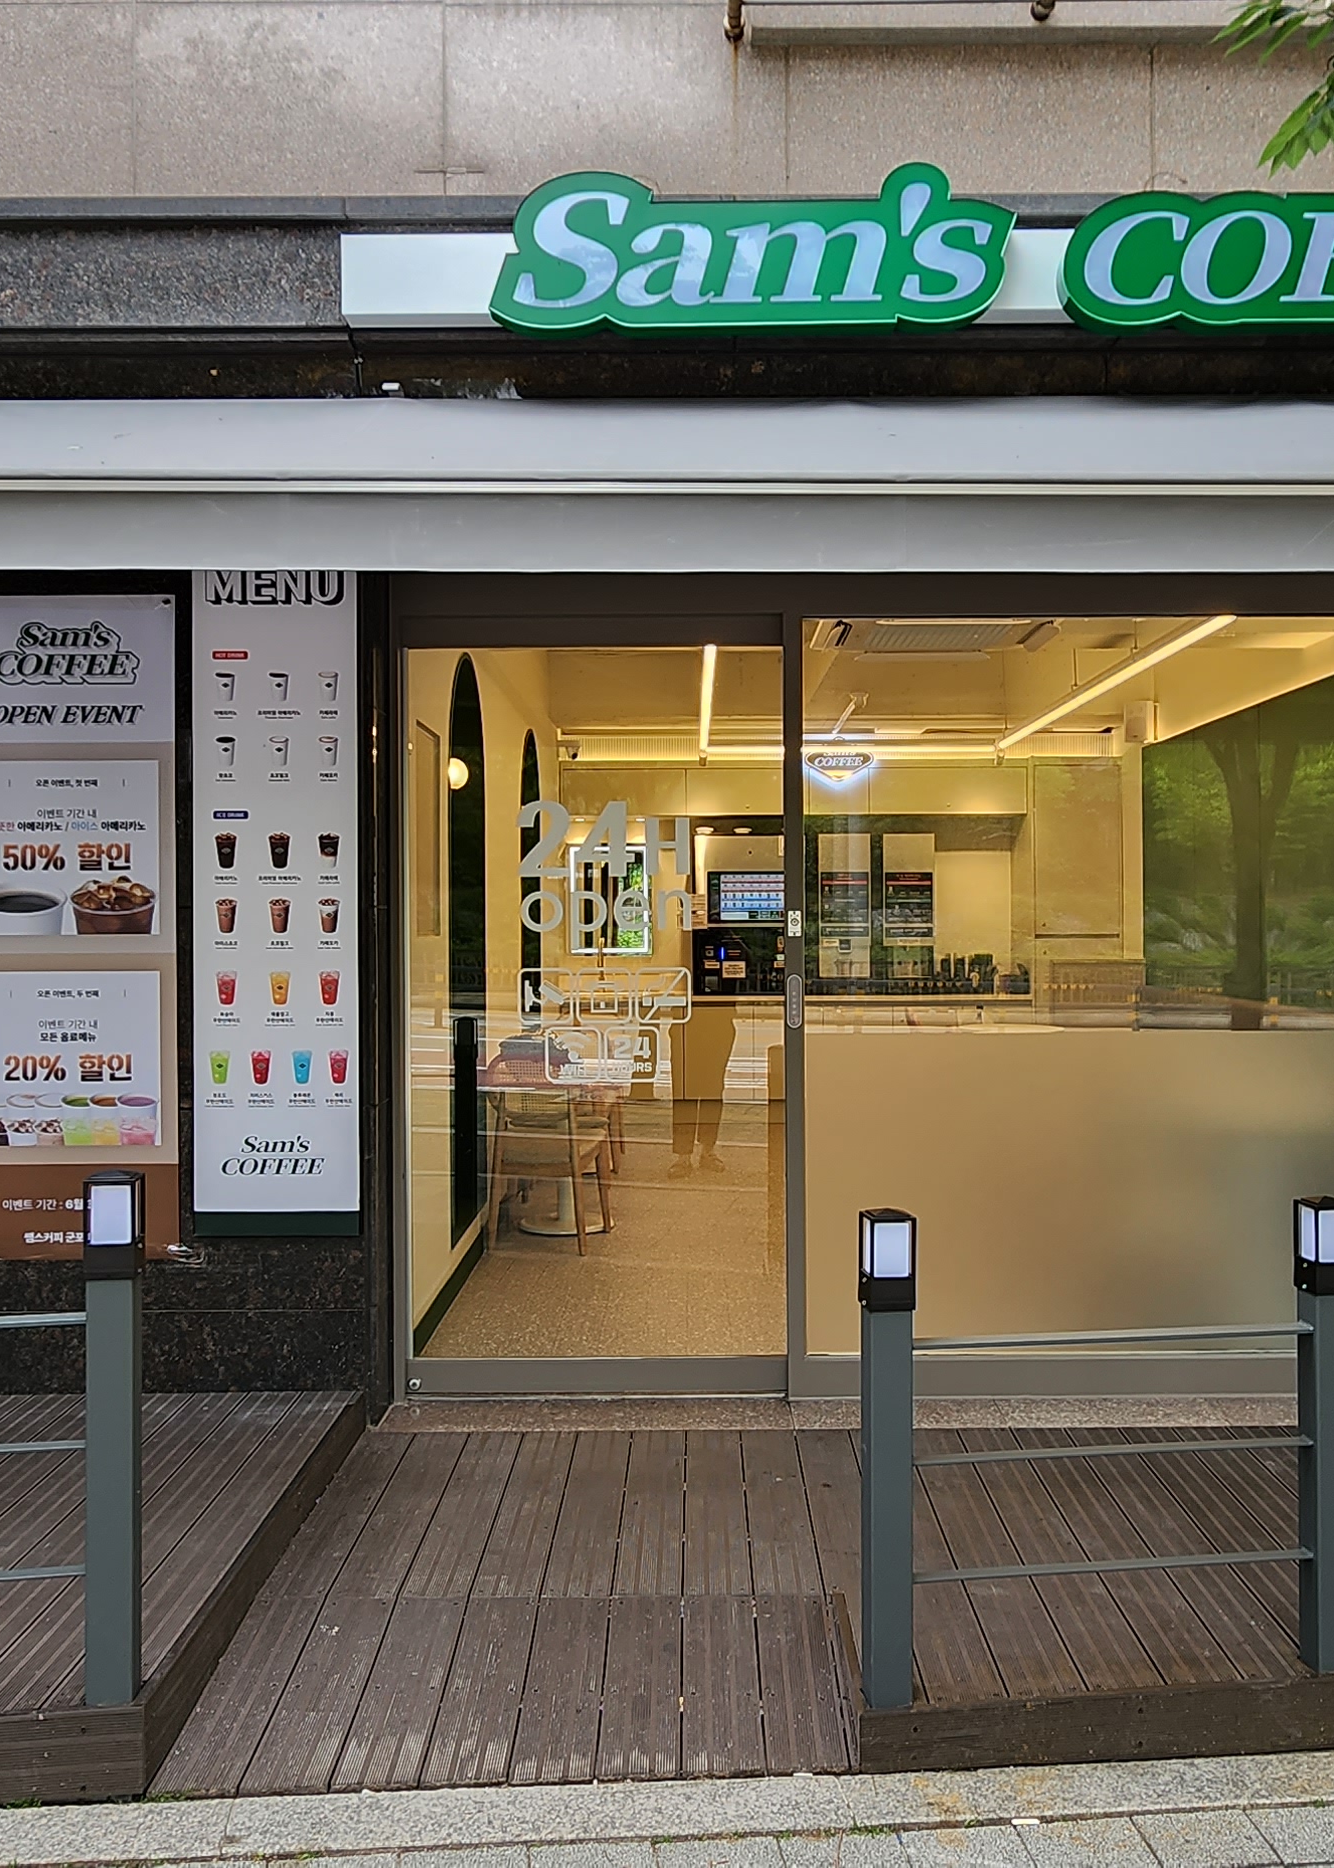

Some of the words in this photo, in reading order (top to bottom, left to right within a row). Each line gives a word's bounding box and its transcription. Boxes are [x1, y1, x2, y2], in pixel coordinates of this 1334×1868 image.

[512, 182, 993, 308] Sam's
[205, 570, 344, 606] MENU
[19, 621, 112, 649] Sam's
[60, 704, 145, 725] EVENT
[37, 809, 64, 819] 이벤트
[66, 809, 85, 819] 기간
[87, 809, 97, 819] 내
[17, 821, 63, 832] 아메리카노
[71, 821, 99, 831] 아이스
[101, 821, 146, 832] 아메리카노
[2, 843, 66, 871] 50%
[77, 842, 132, 871] 할인
[520, 887, 693, 950] open
[38, 1020, 66, 1030] 이벤트
[68, 1020, 86, 1030] 기간
[88, 1020, 99, 1030] 내
[3, 1054, 67, 1081] 20%
[78, 1053, 133, 1082] 할인
[241, 1135, 310, 1154] Sam's
[221, 1157, 325, 1176] COFFEE
[2, 1198, 34, 1211] 이벤트
[35, 1198, 57, 1211] 기간
[65, 1231, 91, 1243] 군포
